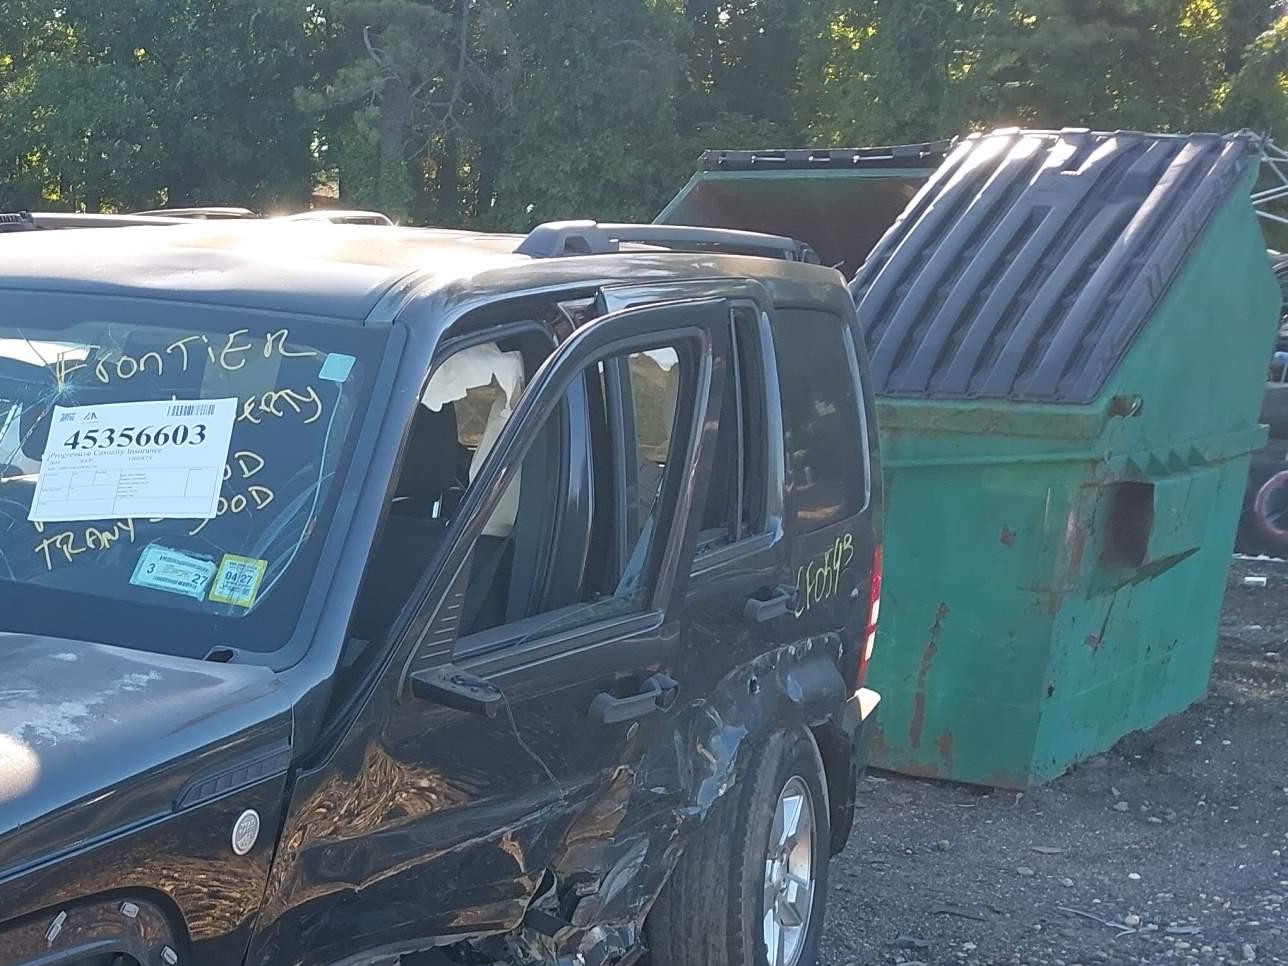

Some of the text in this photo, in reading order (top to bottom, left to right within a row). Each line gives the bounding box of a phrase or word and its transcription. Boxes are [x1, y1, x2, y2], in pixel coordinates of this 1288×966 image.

[64, 424, 207, 450] 45356603
[146, 563, 156, 574] 3
[191, 573, 208, 586] 27
[225, 570, 253, 585] 04 27
